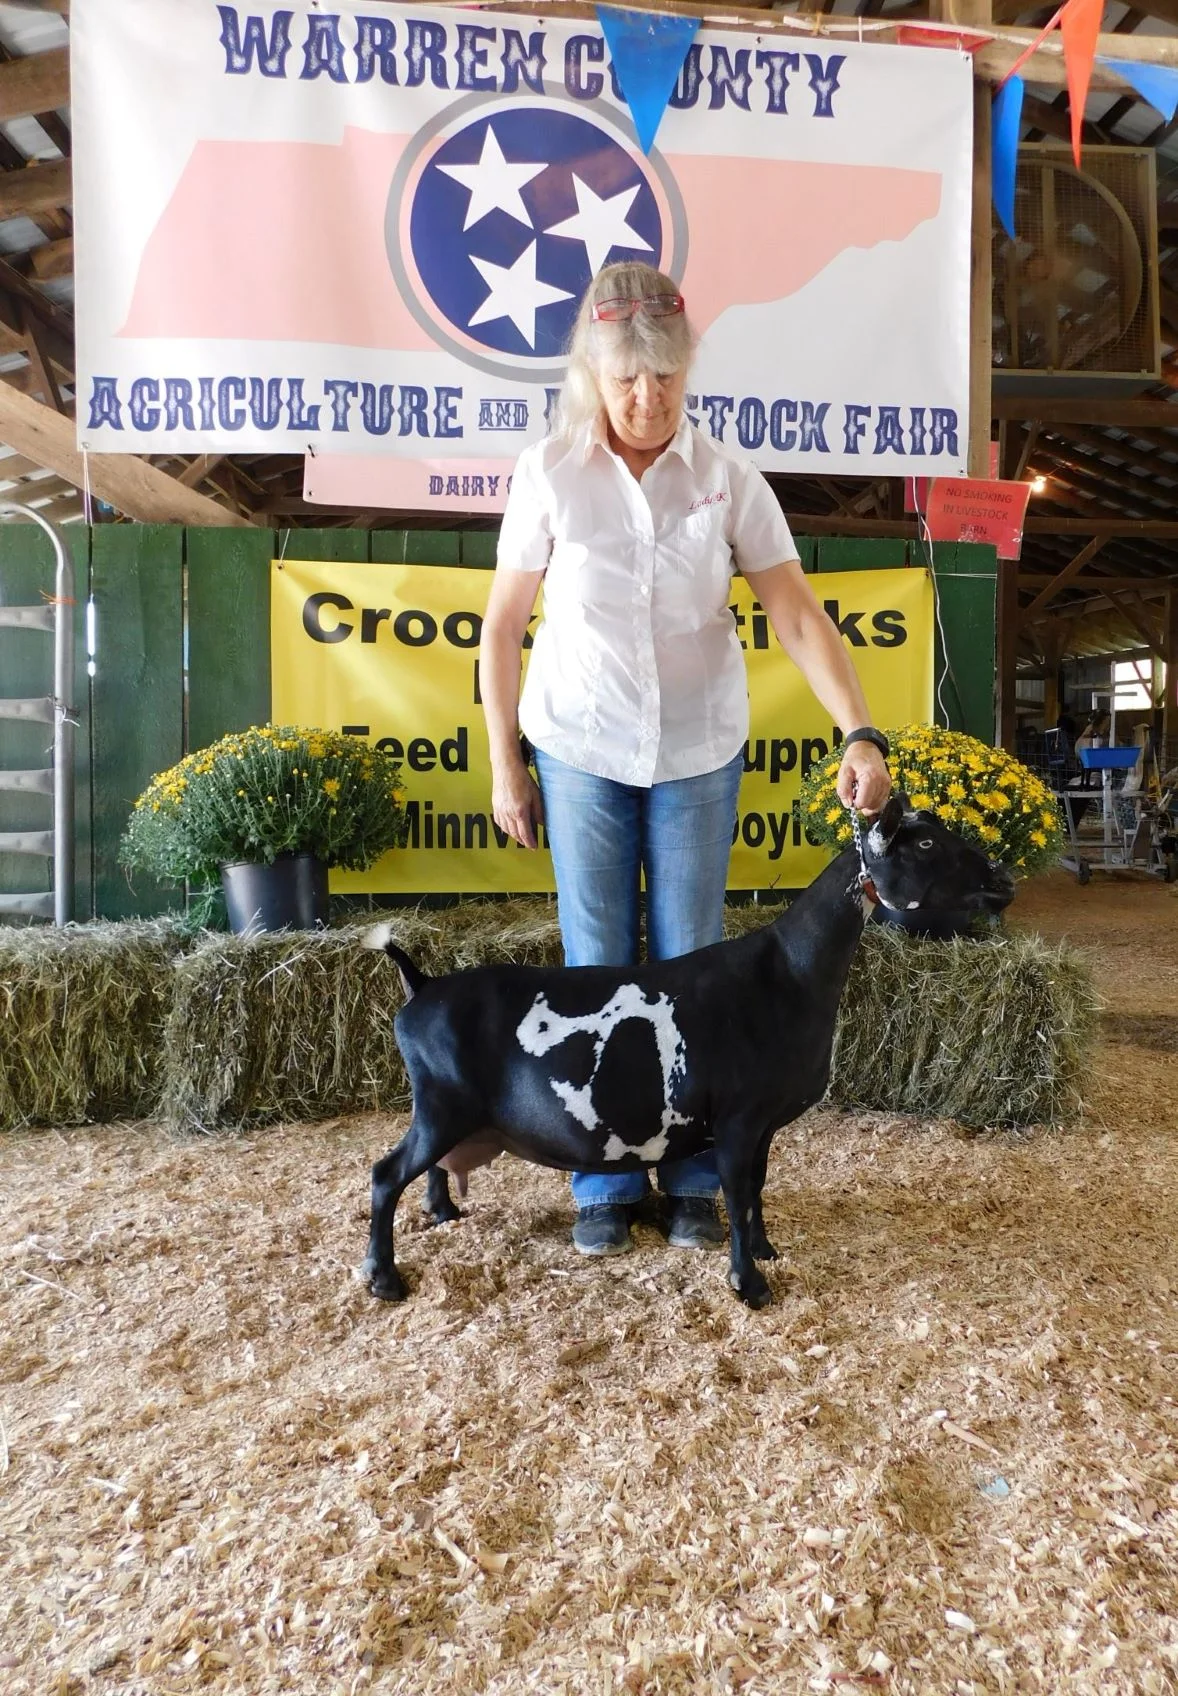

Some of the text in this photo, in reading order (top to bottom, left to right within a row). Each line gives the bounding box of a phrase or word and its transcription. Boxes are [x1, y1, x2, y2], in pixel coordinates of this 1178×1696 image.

[216, 5, 847, 117] WARREN CUNTY
[87, 376, 464, 438] AGRICULTURE
[478, 402, 529, 428] AND
[842, 404, 960, 456] FAIR
[429, 475, 500, 497] DAIRY
[945, 487, 1013, 503] NO SMOKING
[943, 503, 1009, 520] IN LIVESTOCK
[342, 725, 468, 772] eed
